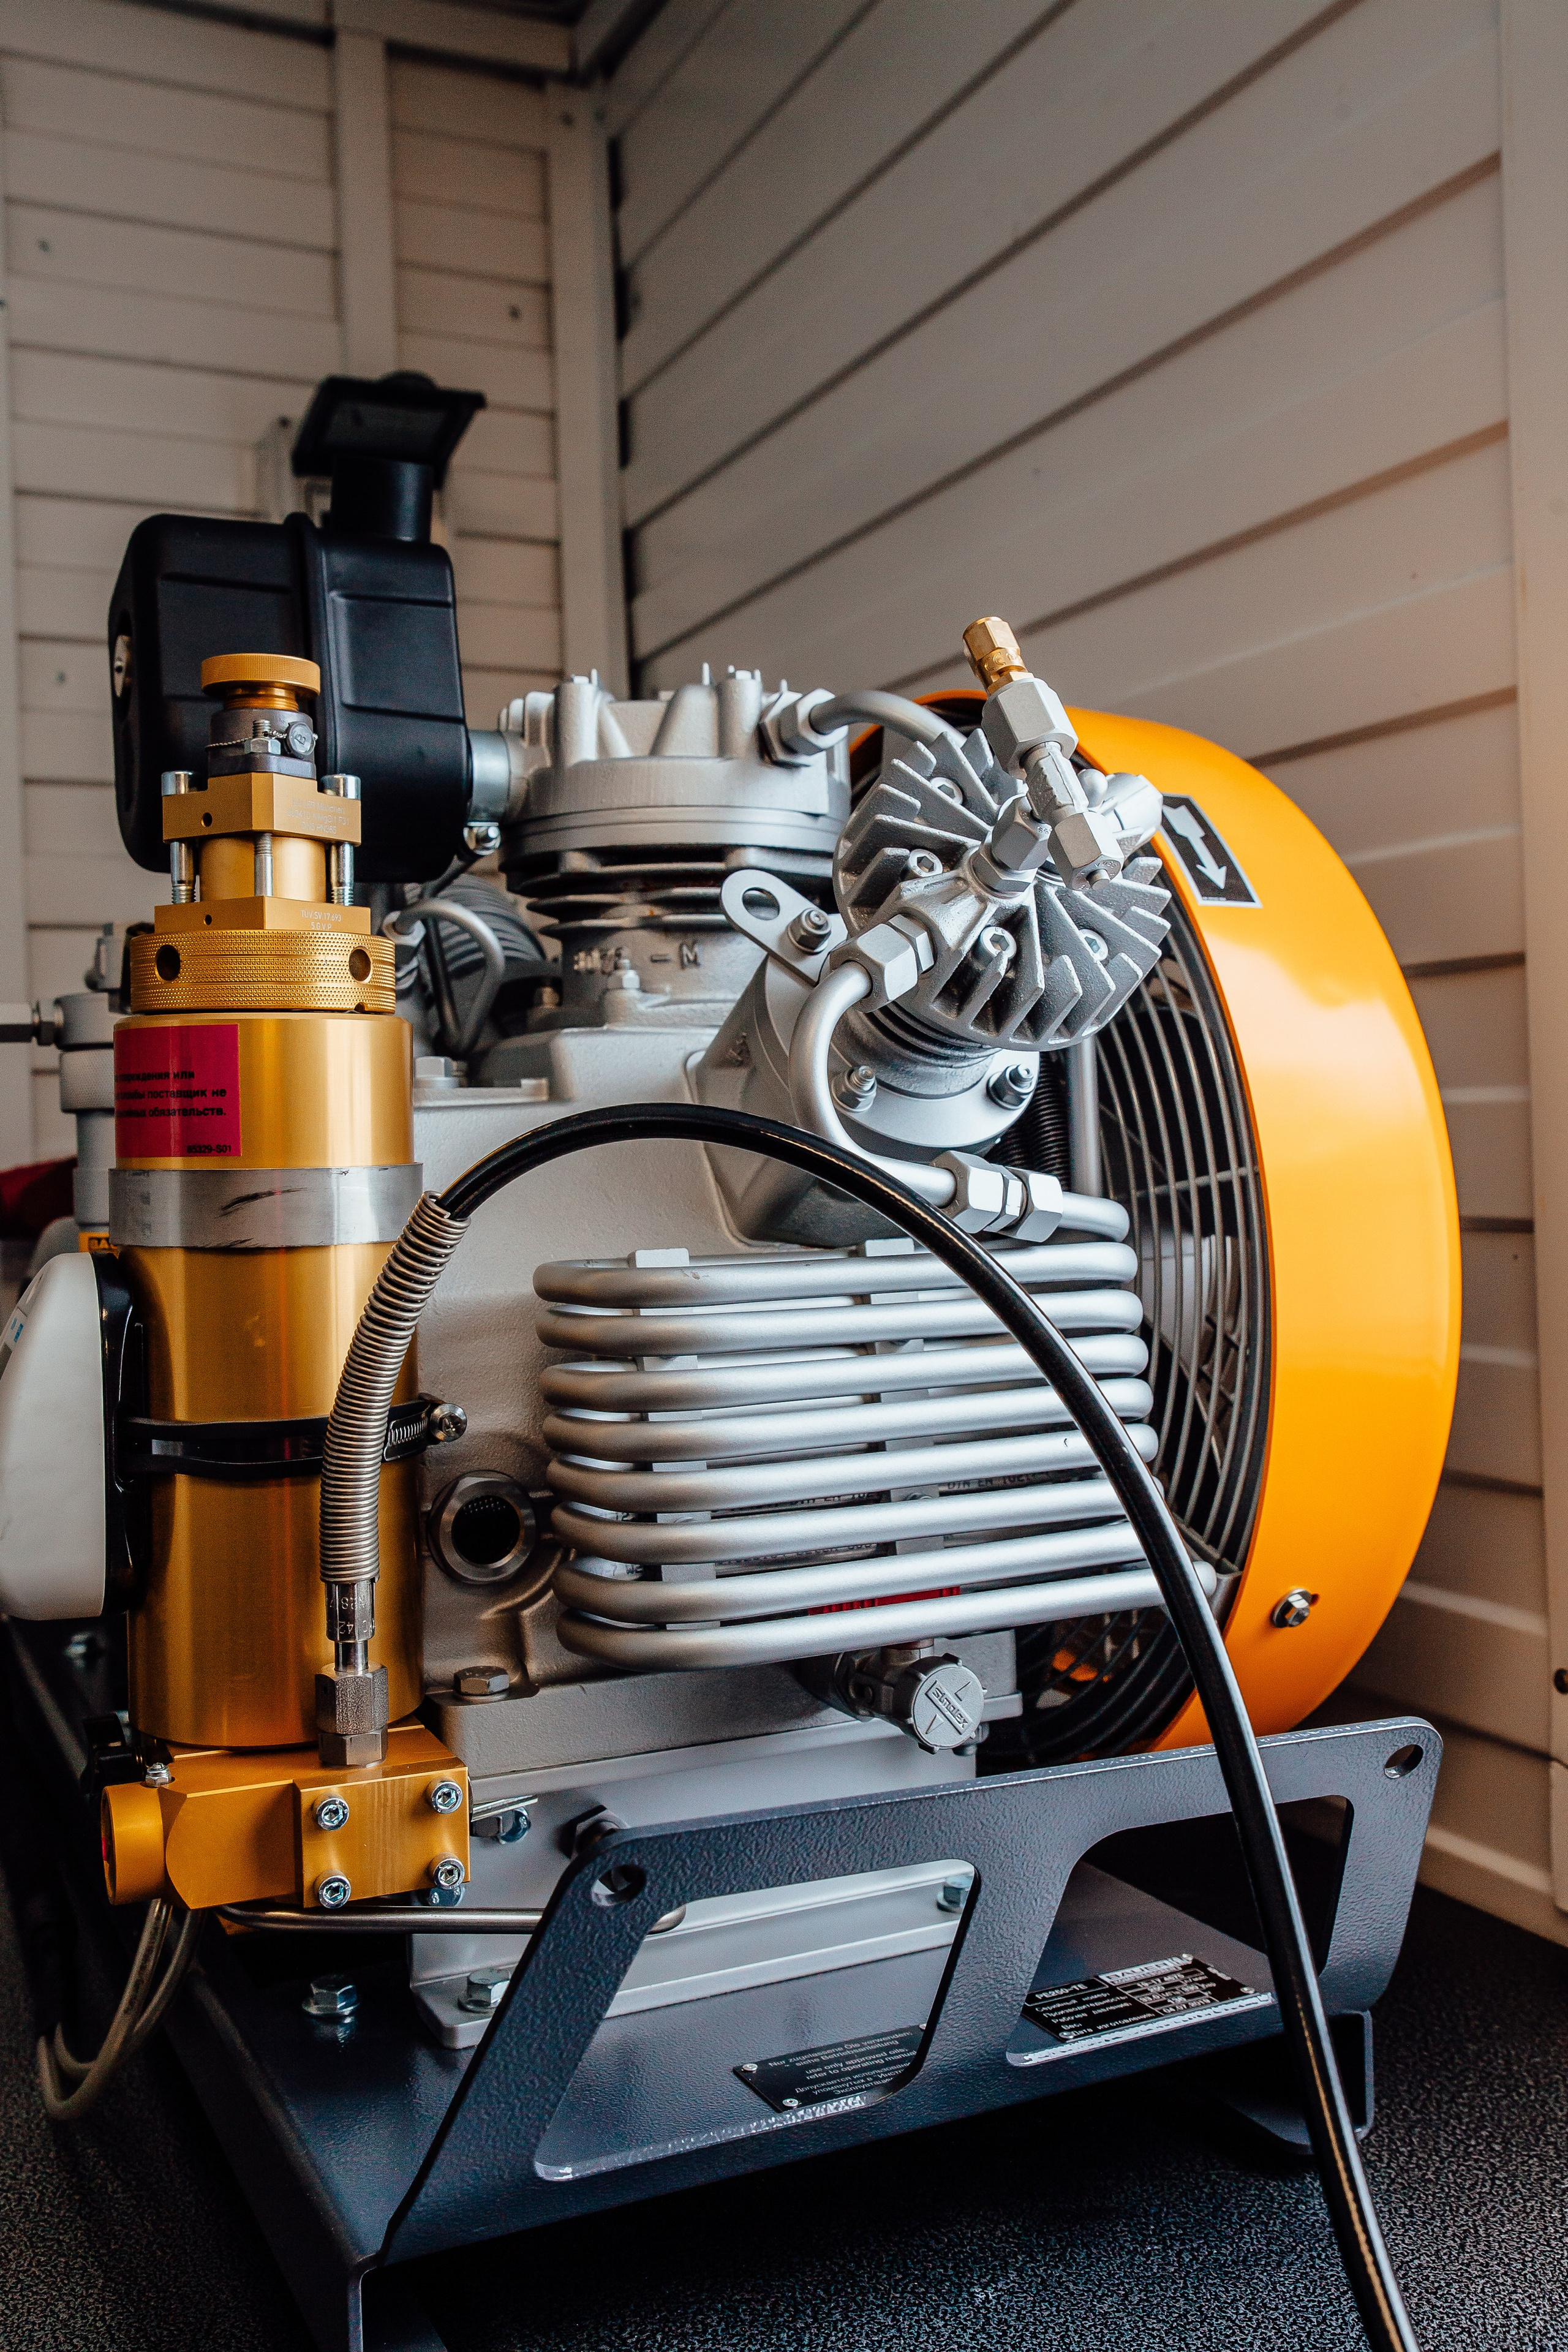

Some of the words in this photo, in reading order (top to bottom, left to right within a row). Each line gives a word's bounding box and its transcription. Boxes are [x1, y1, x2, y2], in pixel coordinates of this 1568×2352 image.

[173, 1071, 195, 1079] или
[147, 1088, 207, 1099] поставщик
[212, 1088, 227, 1097] не
[148, 1106, 227, 1117] обязательств.
[931, 1686, 970, 1730] simplex
[788, 2046, 843, 2063] zugelassene
[821, 2040, 899, 2060] Betriebsanleitung
[806, 2071, 827, 2080] refer
[840, 2058, 885, 2072] operating
[884, 2050, 918, 2062] manual
[824, 2062, 843, 2071] only
[845, 2051, 888, 2067] approved
[795, 2076, 852, 2094] Допускается
[852, 2062, 911, 2079] использовани
[812, 2078, 865, 2095] упомянутых
